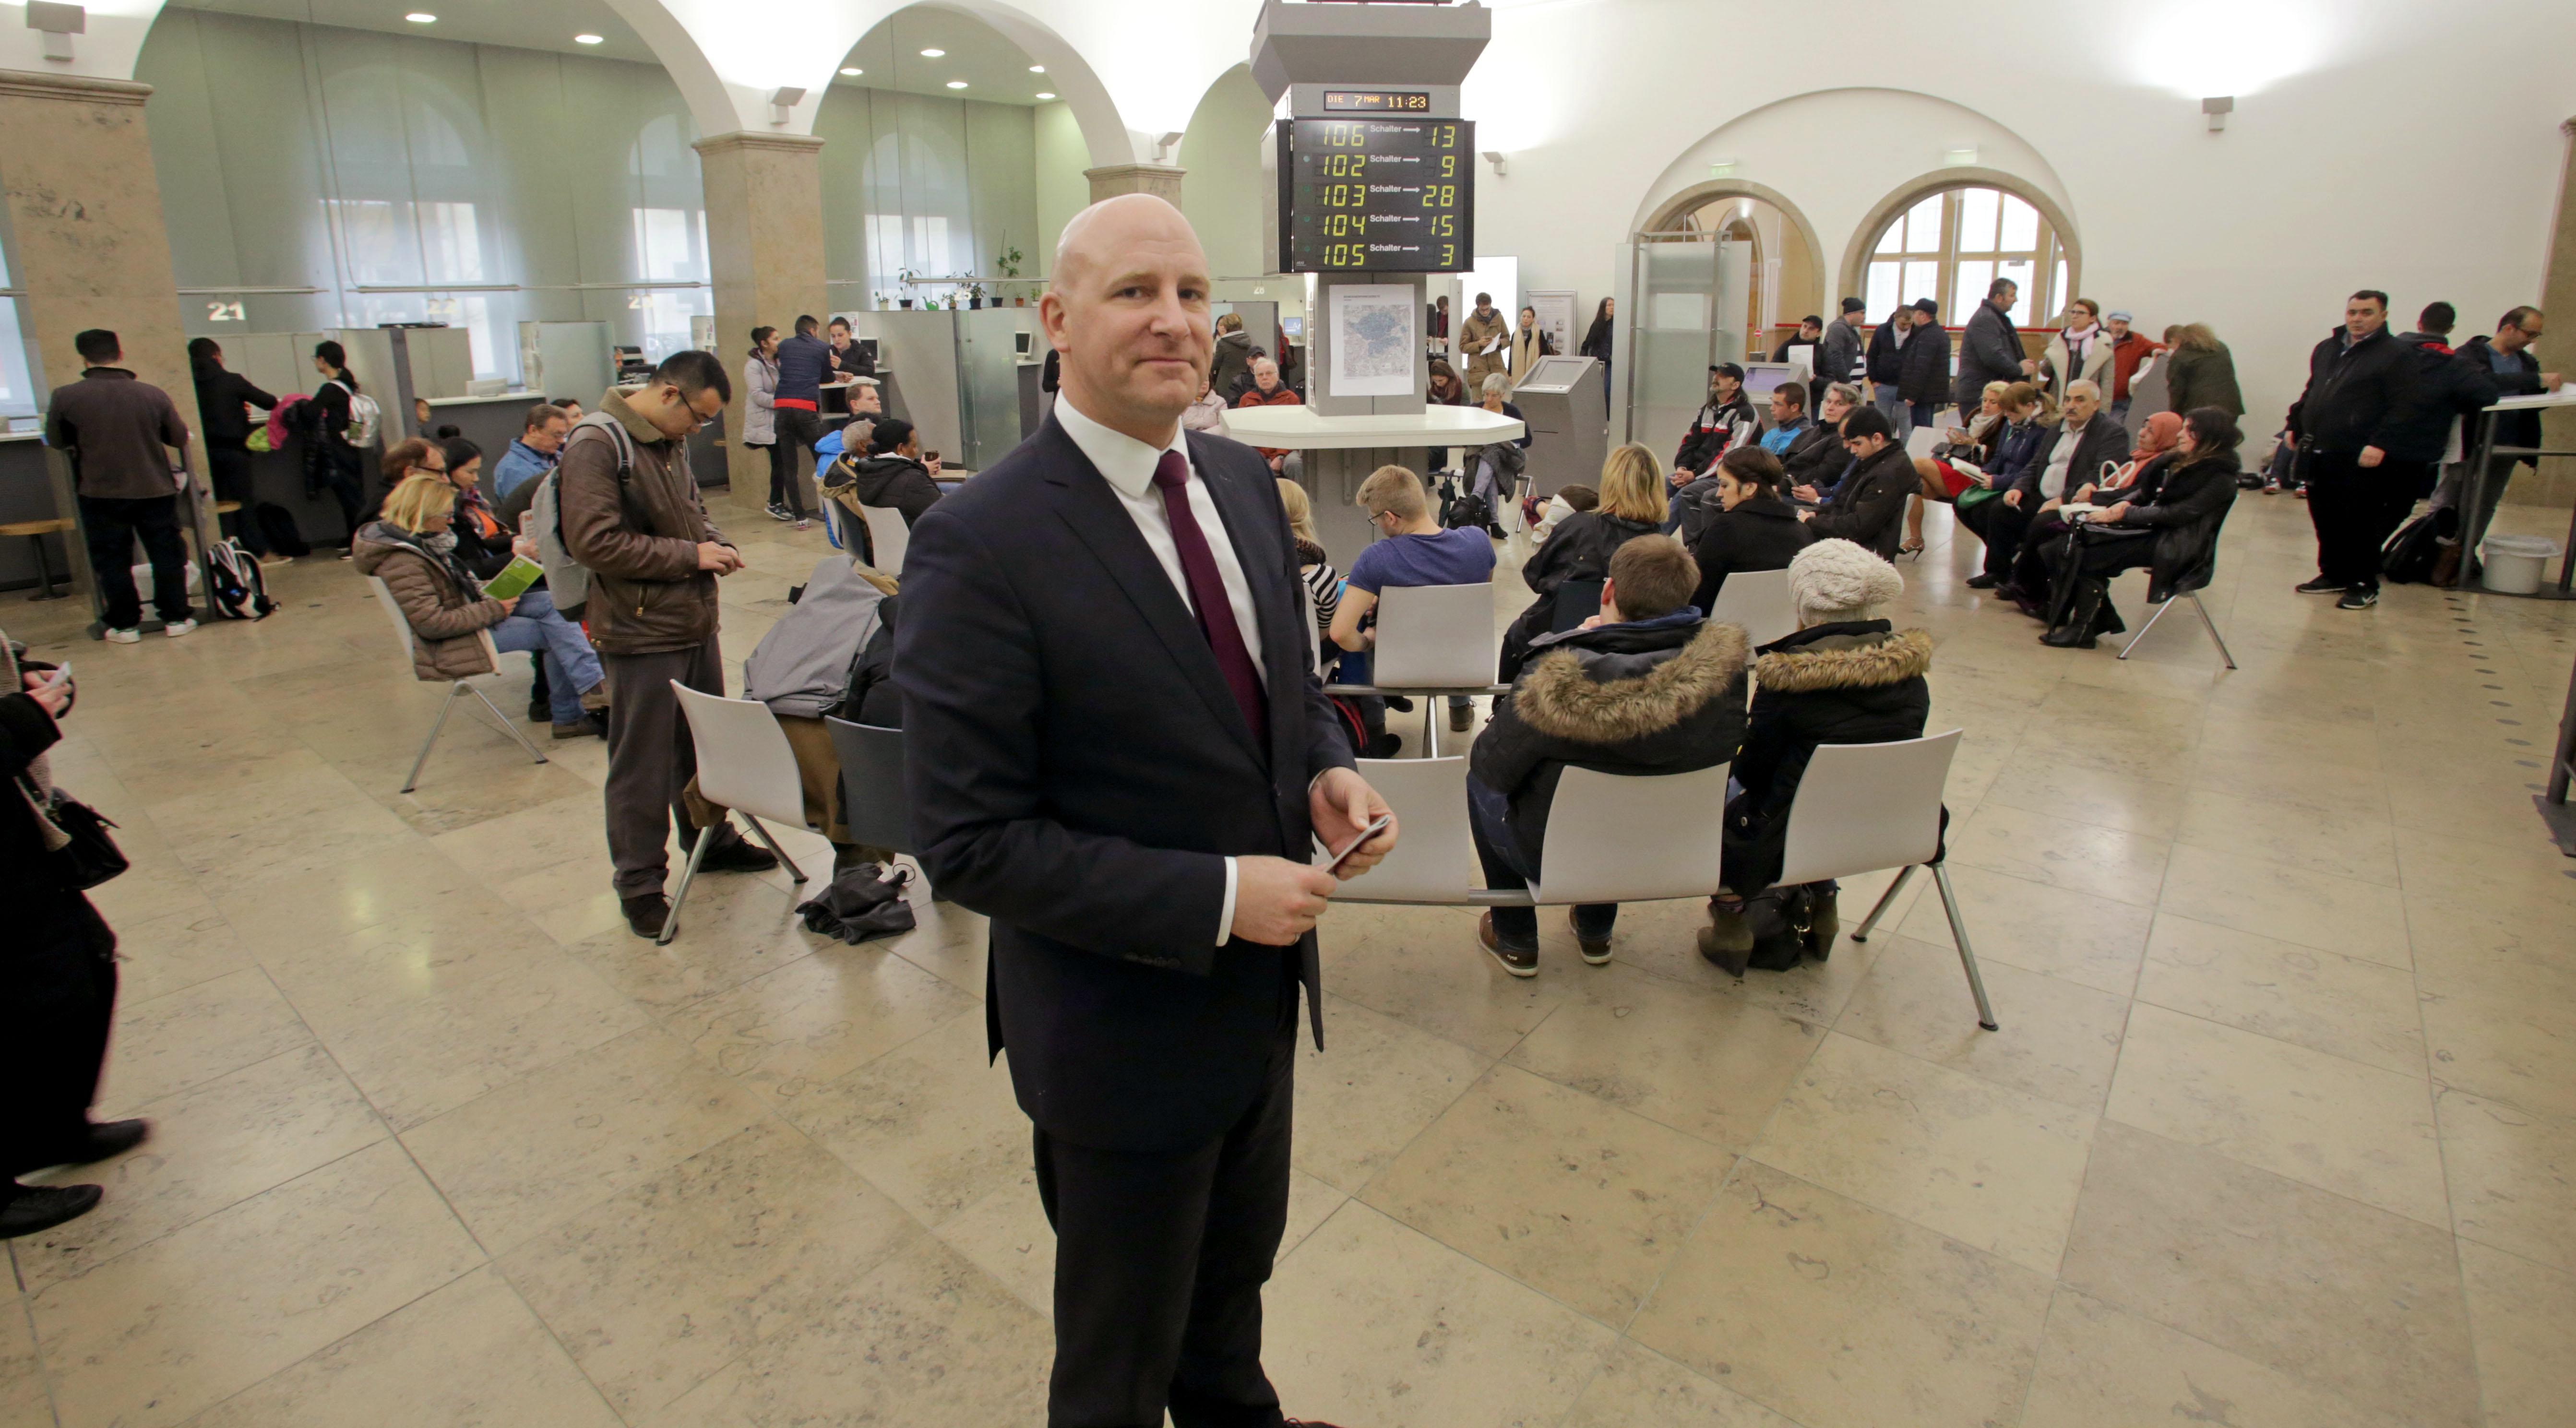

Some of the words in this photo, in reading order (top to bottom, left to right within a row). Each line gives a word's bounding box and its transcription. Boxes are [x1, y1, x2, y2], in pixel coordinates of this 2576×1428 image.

[1354, 95, 1362, 107] 7
[1388, 96, 1426, 108] 11:23
[1324, 125, 1365, 146] 106
[1431, 126, 1455, 147] 13
[1324, 155, 1366, 177] 102
[1441, 155, 1455, 177] 9
[1324, 185, 1366, 206] 103
[1422, 185, 1455, 207] 28
[1324, 214, 1366, 236] 104
[1431, 215, 1454, 236] 15
[1324, 244, 1365, 266] 105
[1440, 244, 1455, 266] 3
[954, 288, 972, 300] 25
[207, 301, 246, 321] 21
